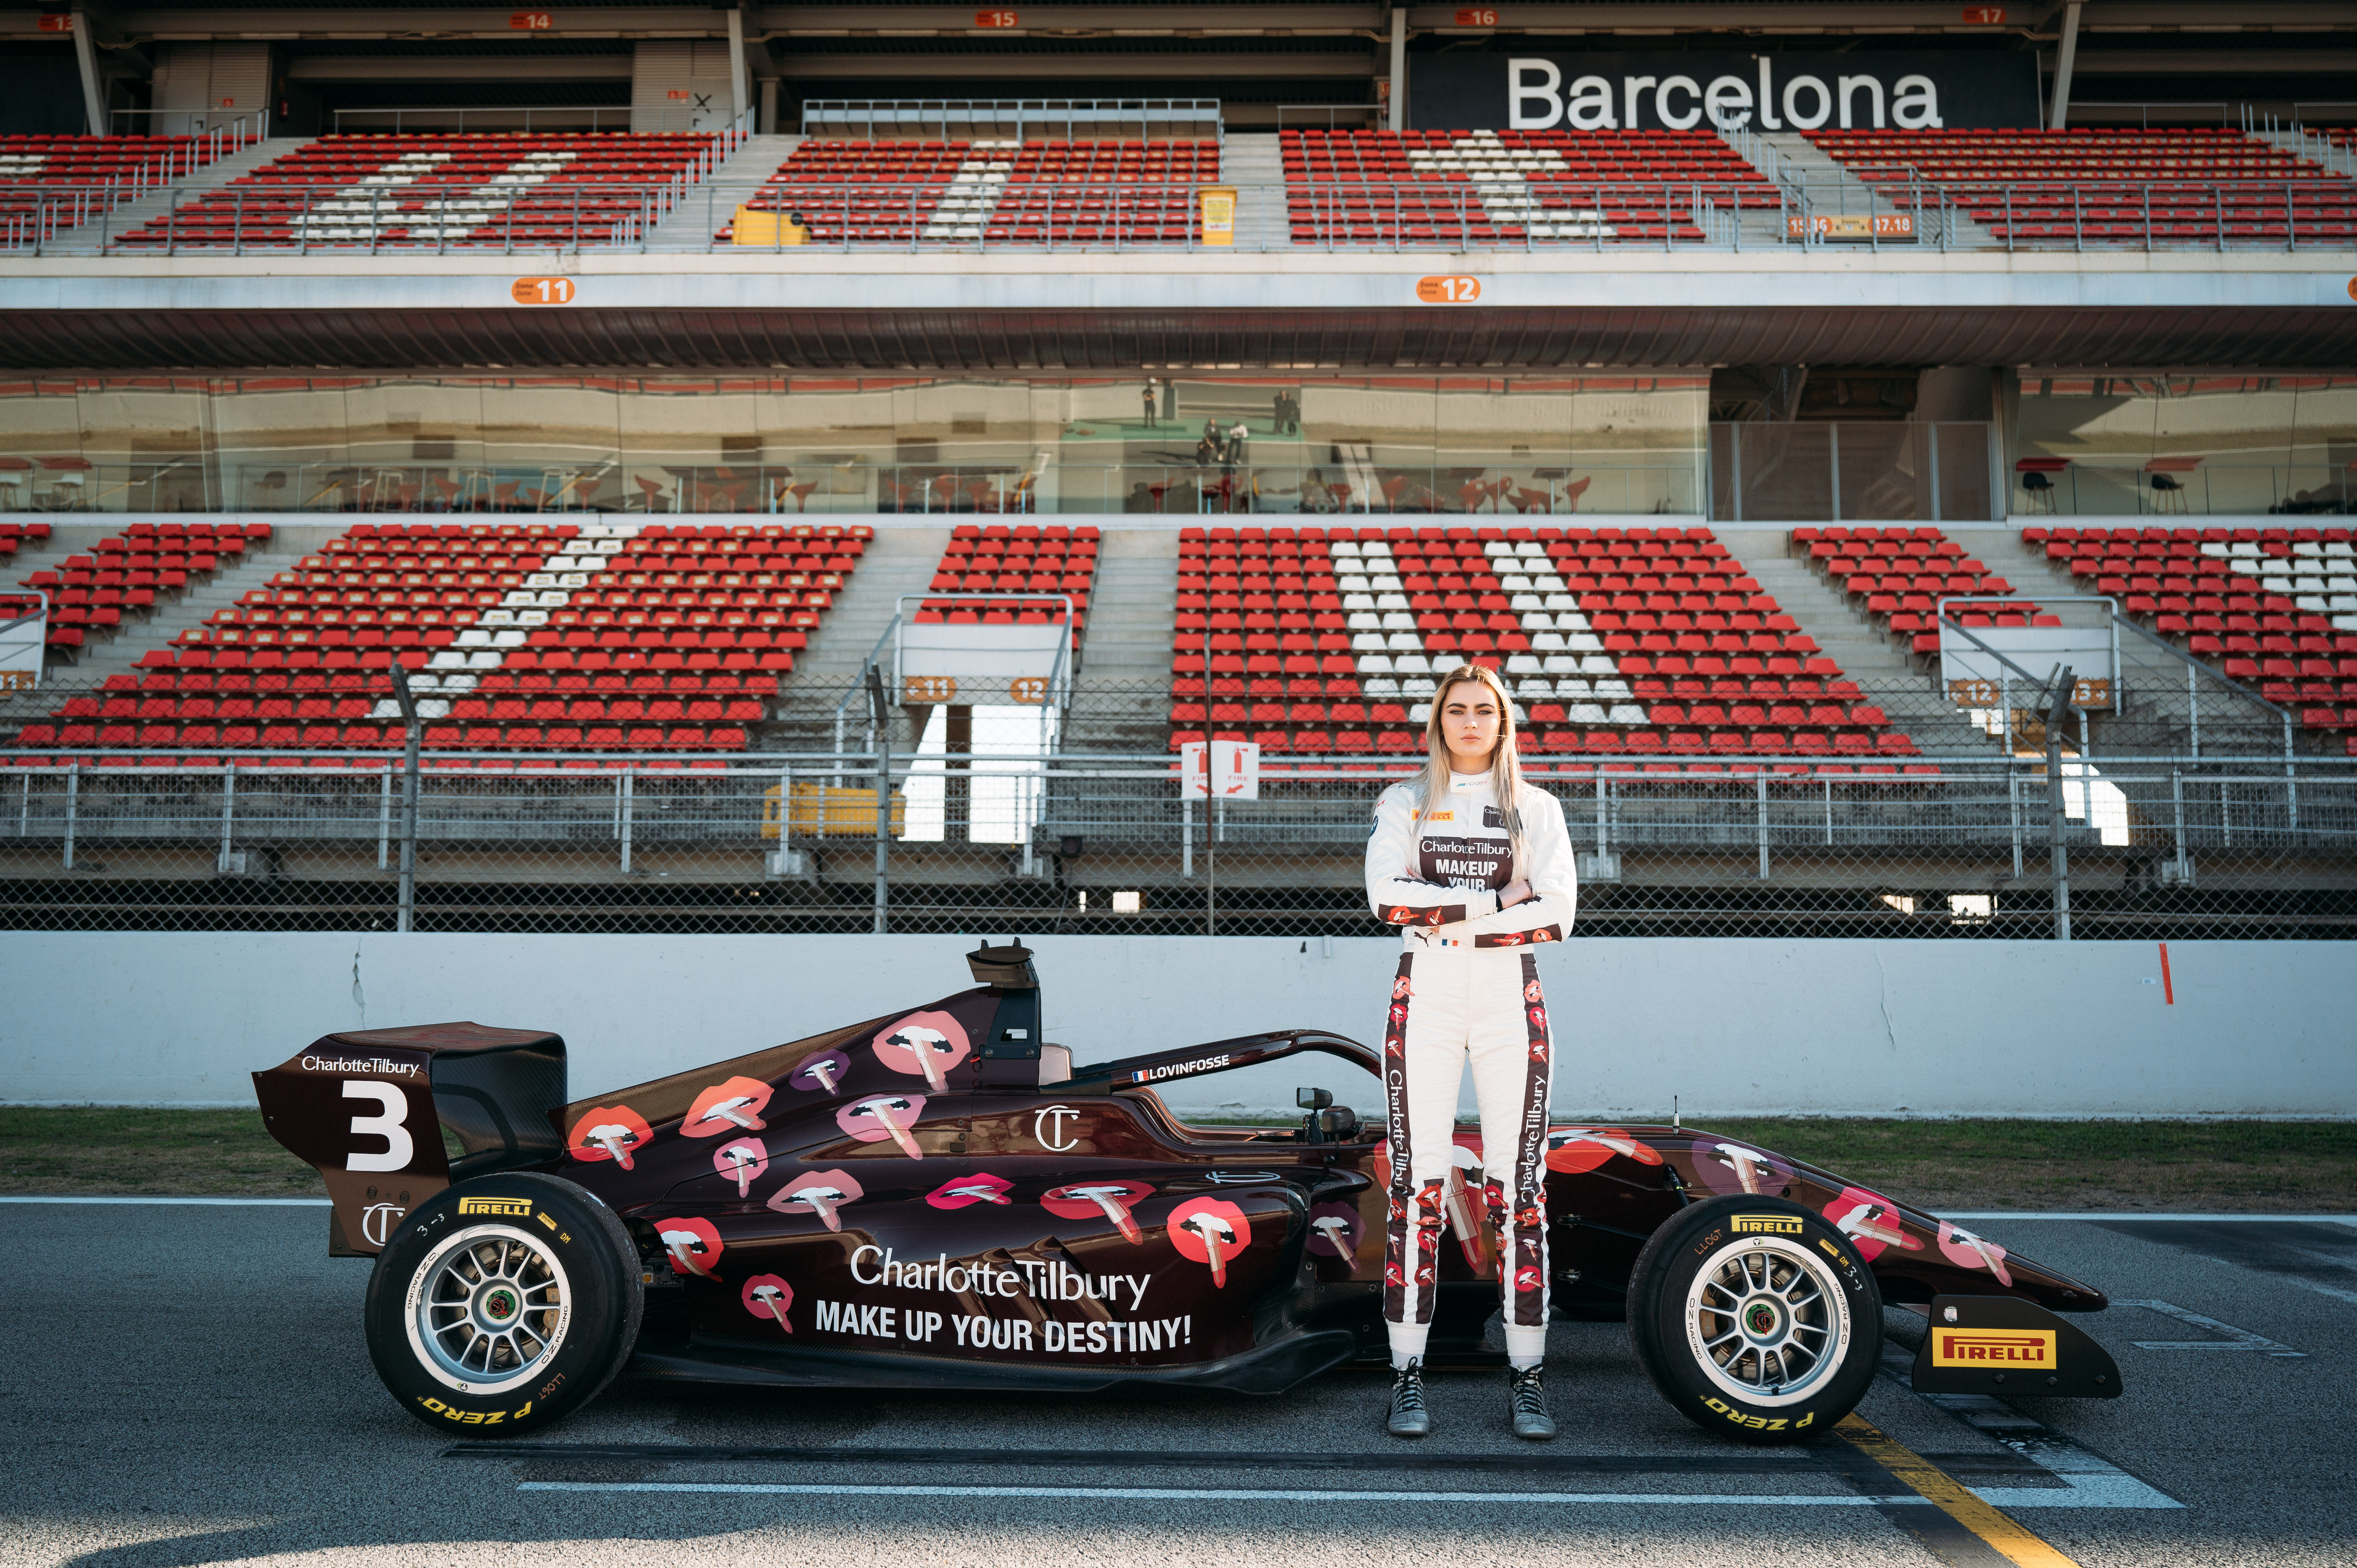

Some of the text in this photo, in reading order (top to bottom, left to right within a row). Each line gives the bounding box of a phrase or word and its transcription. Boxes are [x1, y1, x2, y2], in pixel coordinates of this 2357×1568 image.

[527, 15, 548, 28] 14
[992, 12, 1014, 27] 15
[1472, 11, 1494, 25] 16
[1980, 8, 2001, 23] 17
[1508, 57, 1943, 130] Barcelona
[537, 280, 567, 301] 11
[1442, 278, 1474, 301] 12
[924, 680, 948, 696] 11
[1018, 680, 1043, 698] 12
[1967, 683, 1992, 701] 12
[1436, 859, 1498, 876] MAKEUP
[1448, 877, 1485, 892] YOUR
[302, 1056, 420, 1078] CharlotteTilbury
[1149, 1054, 1230, 1079] LOVINFOSSE
[342, 1080, 413, 1172] 3
[458, 1197, 533, 1216] PIRELLI
[1731, 1215, 1803, 1233] PIRELLI
[560, 1233, 571, 1243] DM
[1839, 1256, 1850, 1267] DM
[850, 1245, 1151, 1311] CharlotteTilbury
[407, 1273, 421, 1309] RACING
[1834, 1283, 1848, 1320] RACING
[555, 1305, 568, 1343] RACING
[816, 1300, 1191, 1353] MAKE UP YOUR DESTINY!
[1689, 1323, 1702, 1359] RACING
[1943, 1336, 2045, 1361] PIRELLI
[422, 1398, 506, 1425] ZERO
[514, 1401, 532, 1419] P
[1705, 1398, 1788, 1430] ZERO
[1796, 1412, 1814, 1428] P
